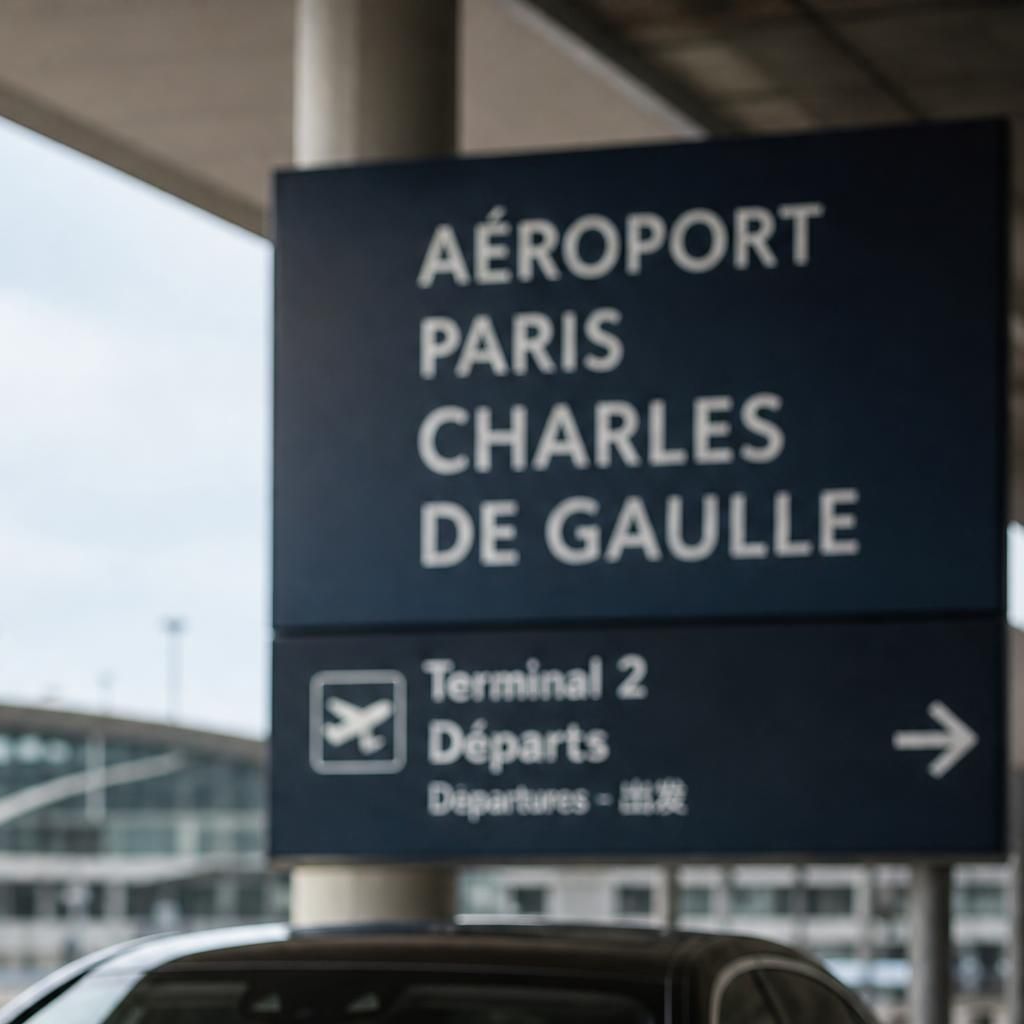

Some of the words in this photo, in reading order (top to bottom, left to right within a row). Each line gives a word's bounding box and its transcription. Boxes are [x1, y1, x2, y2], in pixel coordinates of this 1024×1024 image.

[416, 202, 824, 289] AÉROPORT
[419, 307, 624, 380] PARIS
[417, 393, 785, 476] CHARLES
[420, 500, 520, 569] DE
[544, 488, 860, 566] GAULLE
[422, 656, 603, 704] Terminal
[616, 653, 649, 700] 2
[428, 718, 610, 775] Départs
